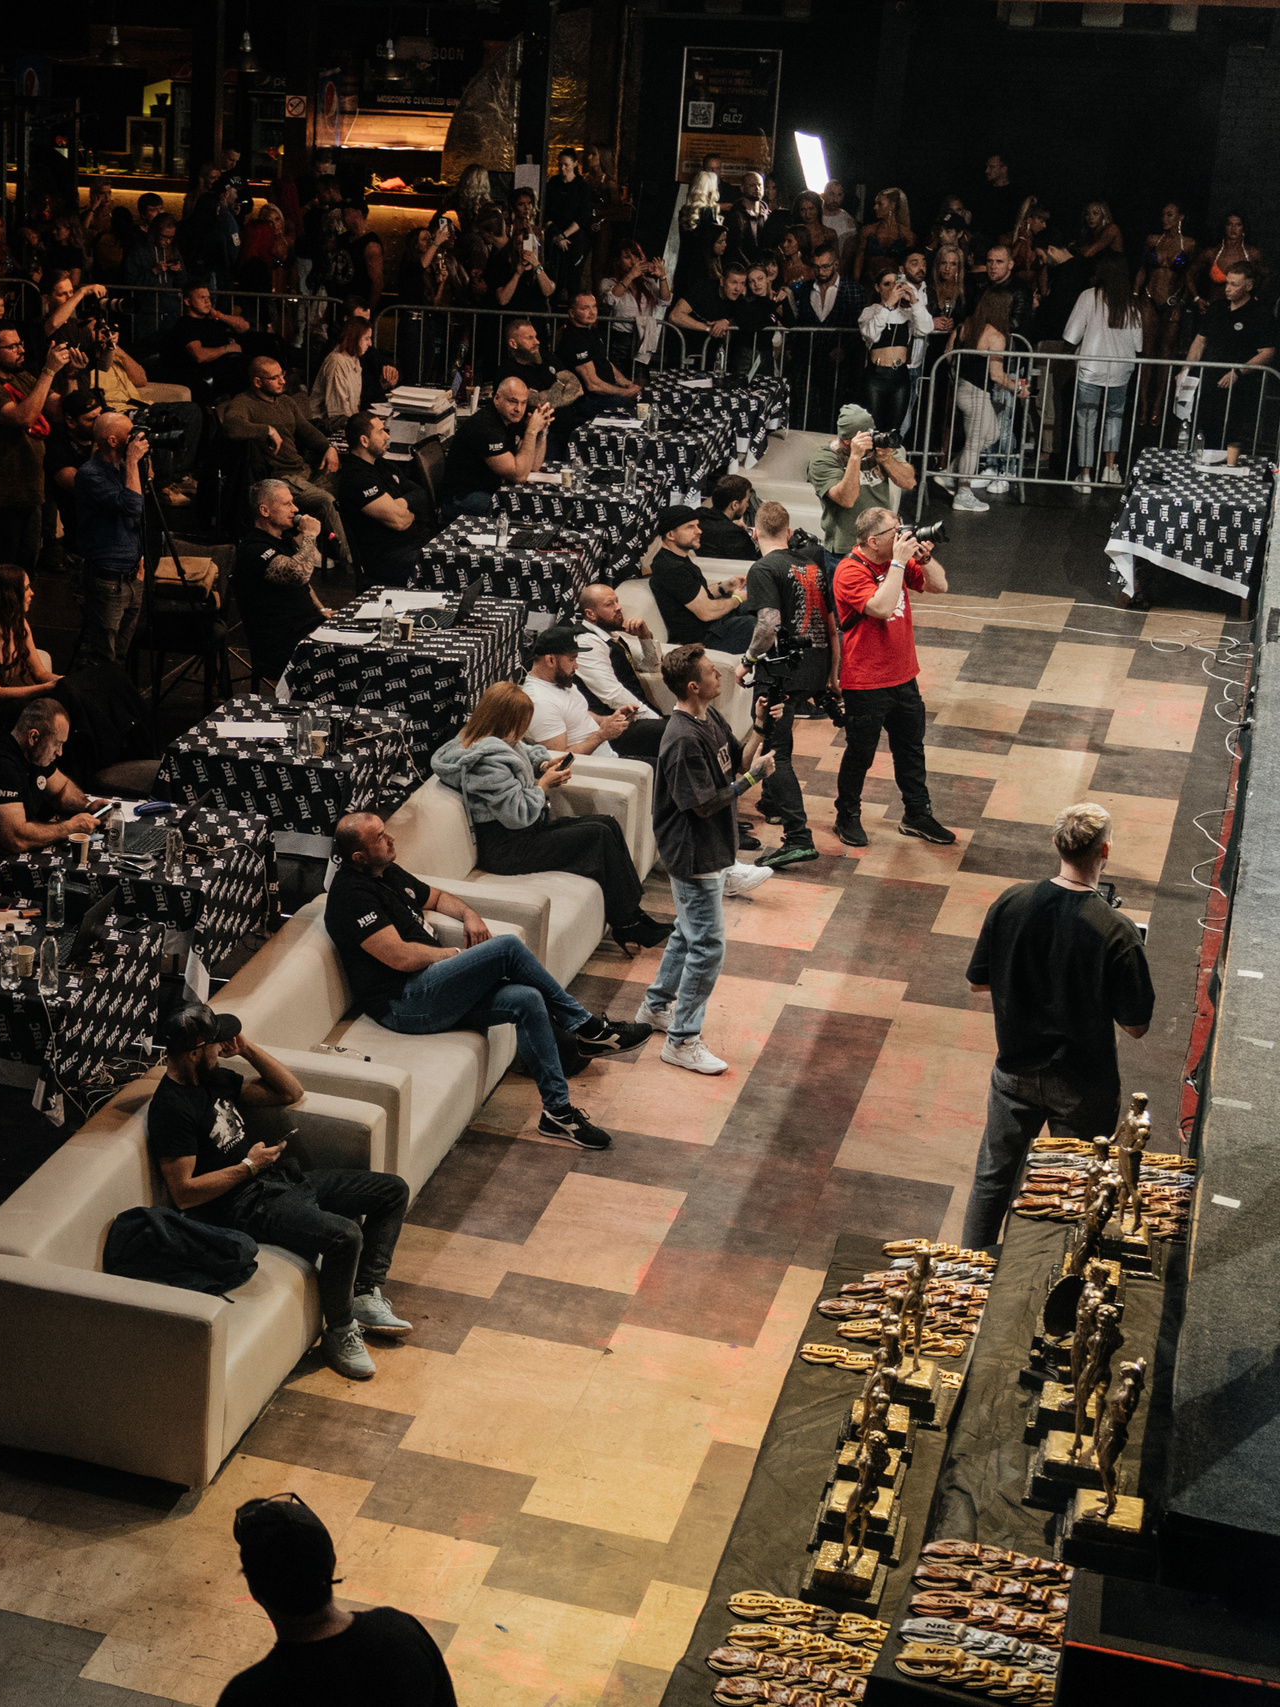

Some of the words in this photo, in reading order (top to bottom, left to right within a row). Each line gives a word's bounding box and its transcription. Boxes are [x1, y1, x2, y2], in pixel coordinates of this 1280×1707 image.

[432, 46, 464, 61] BOON
[1140, 497, 1149, 514] NBC
[1161, 505, 1169, 522] NBC
[1212, 503, 1220, 520] NBC
[1147, 520, 1155, 537] NBC
[1181, 512, 1189, 529] NBC
[1199, 519, 1207, 536] NBC
[1234, 511, 1242, 528] NBC
[1254, 518, 1262, 536] NBC
[1167, 527, 1175, 544] NBC
[1185, 533, 1193, 551] NBC
[1219, 526, 1227, 543] NBC
[1240, 534, 1248, 551] NBC
[1206, 542, 1214, 559] NBC
[1226, 549, 1234, 566] NBC
[1245, 556, 1254, 573] NBC
[432, 564, 444, 584] NBC
[456, 569, 468, 589] NBC
[482, 573, 492, 593] NBC
[508, 577, 519, 597] NBC
[529, 580, 540, 600] NBC
[552, 583, 560, 602] NBC
[193, 759, 208, 782] NBC
[221, 762, 236, 786] NBC
[251, 764, 267, 789] NBC
[276, 767, 292, 791] NBC
[305, 769, 321, 794] NBC
[212, 788, 227, 811] NBC
[241, 791, 256, 813] NBC
[266, 793, 282, 817] NBC
[295, 795, 311, 819] NBC
[324, 798, 336, 823] NBC
[357, 911, 378, 928] NBC
[925, 1622, 955, 1630] NBC
